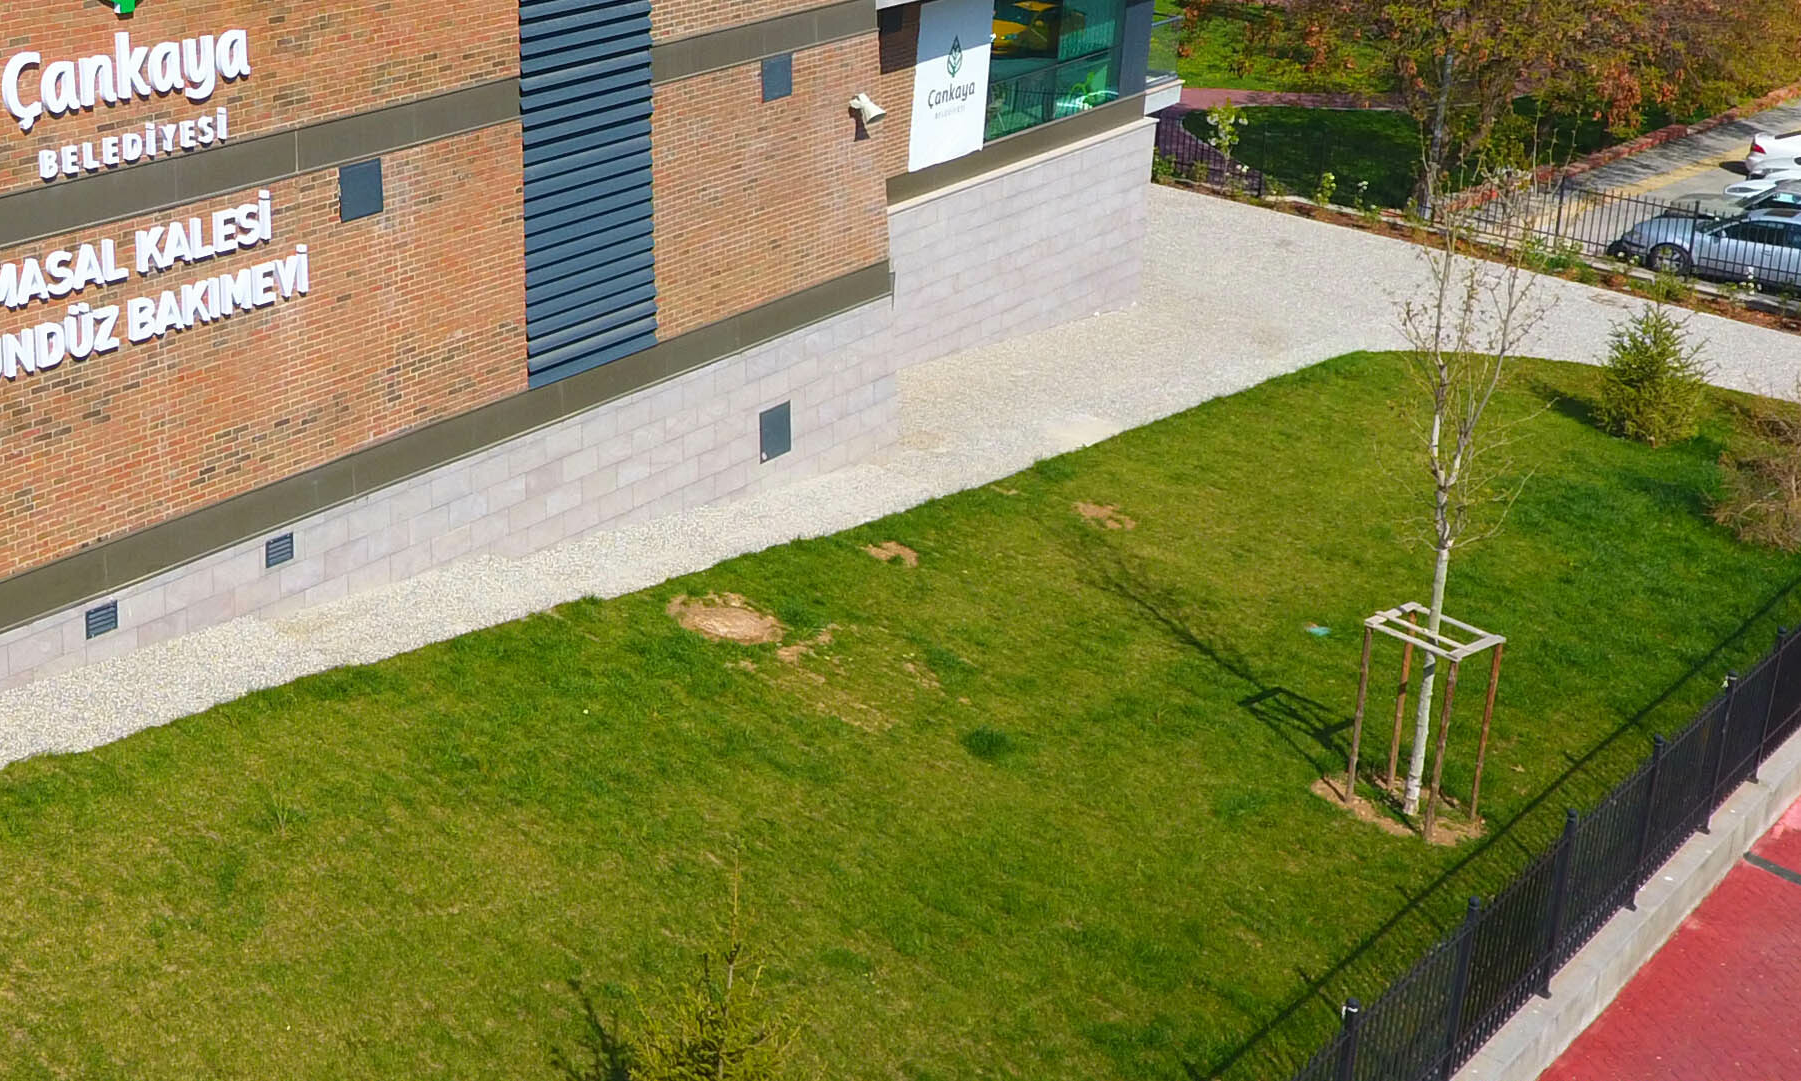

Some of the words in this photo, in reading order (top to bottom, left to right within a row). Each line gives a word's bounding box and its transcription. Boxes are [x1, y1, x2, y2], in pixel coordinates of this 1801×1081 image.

[2, 28, 251, 131] Çankaya
[927, 81, 975, 110] Çankaya
[38, 108, 228, 180] BELEDİYESİ
[135, 190, 272, 273] KALESİ
[128, 244, 309, 343] BAKIMEVİ
